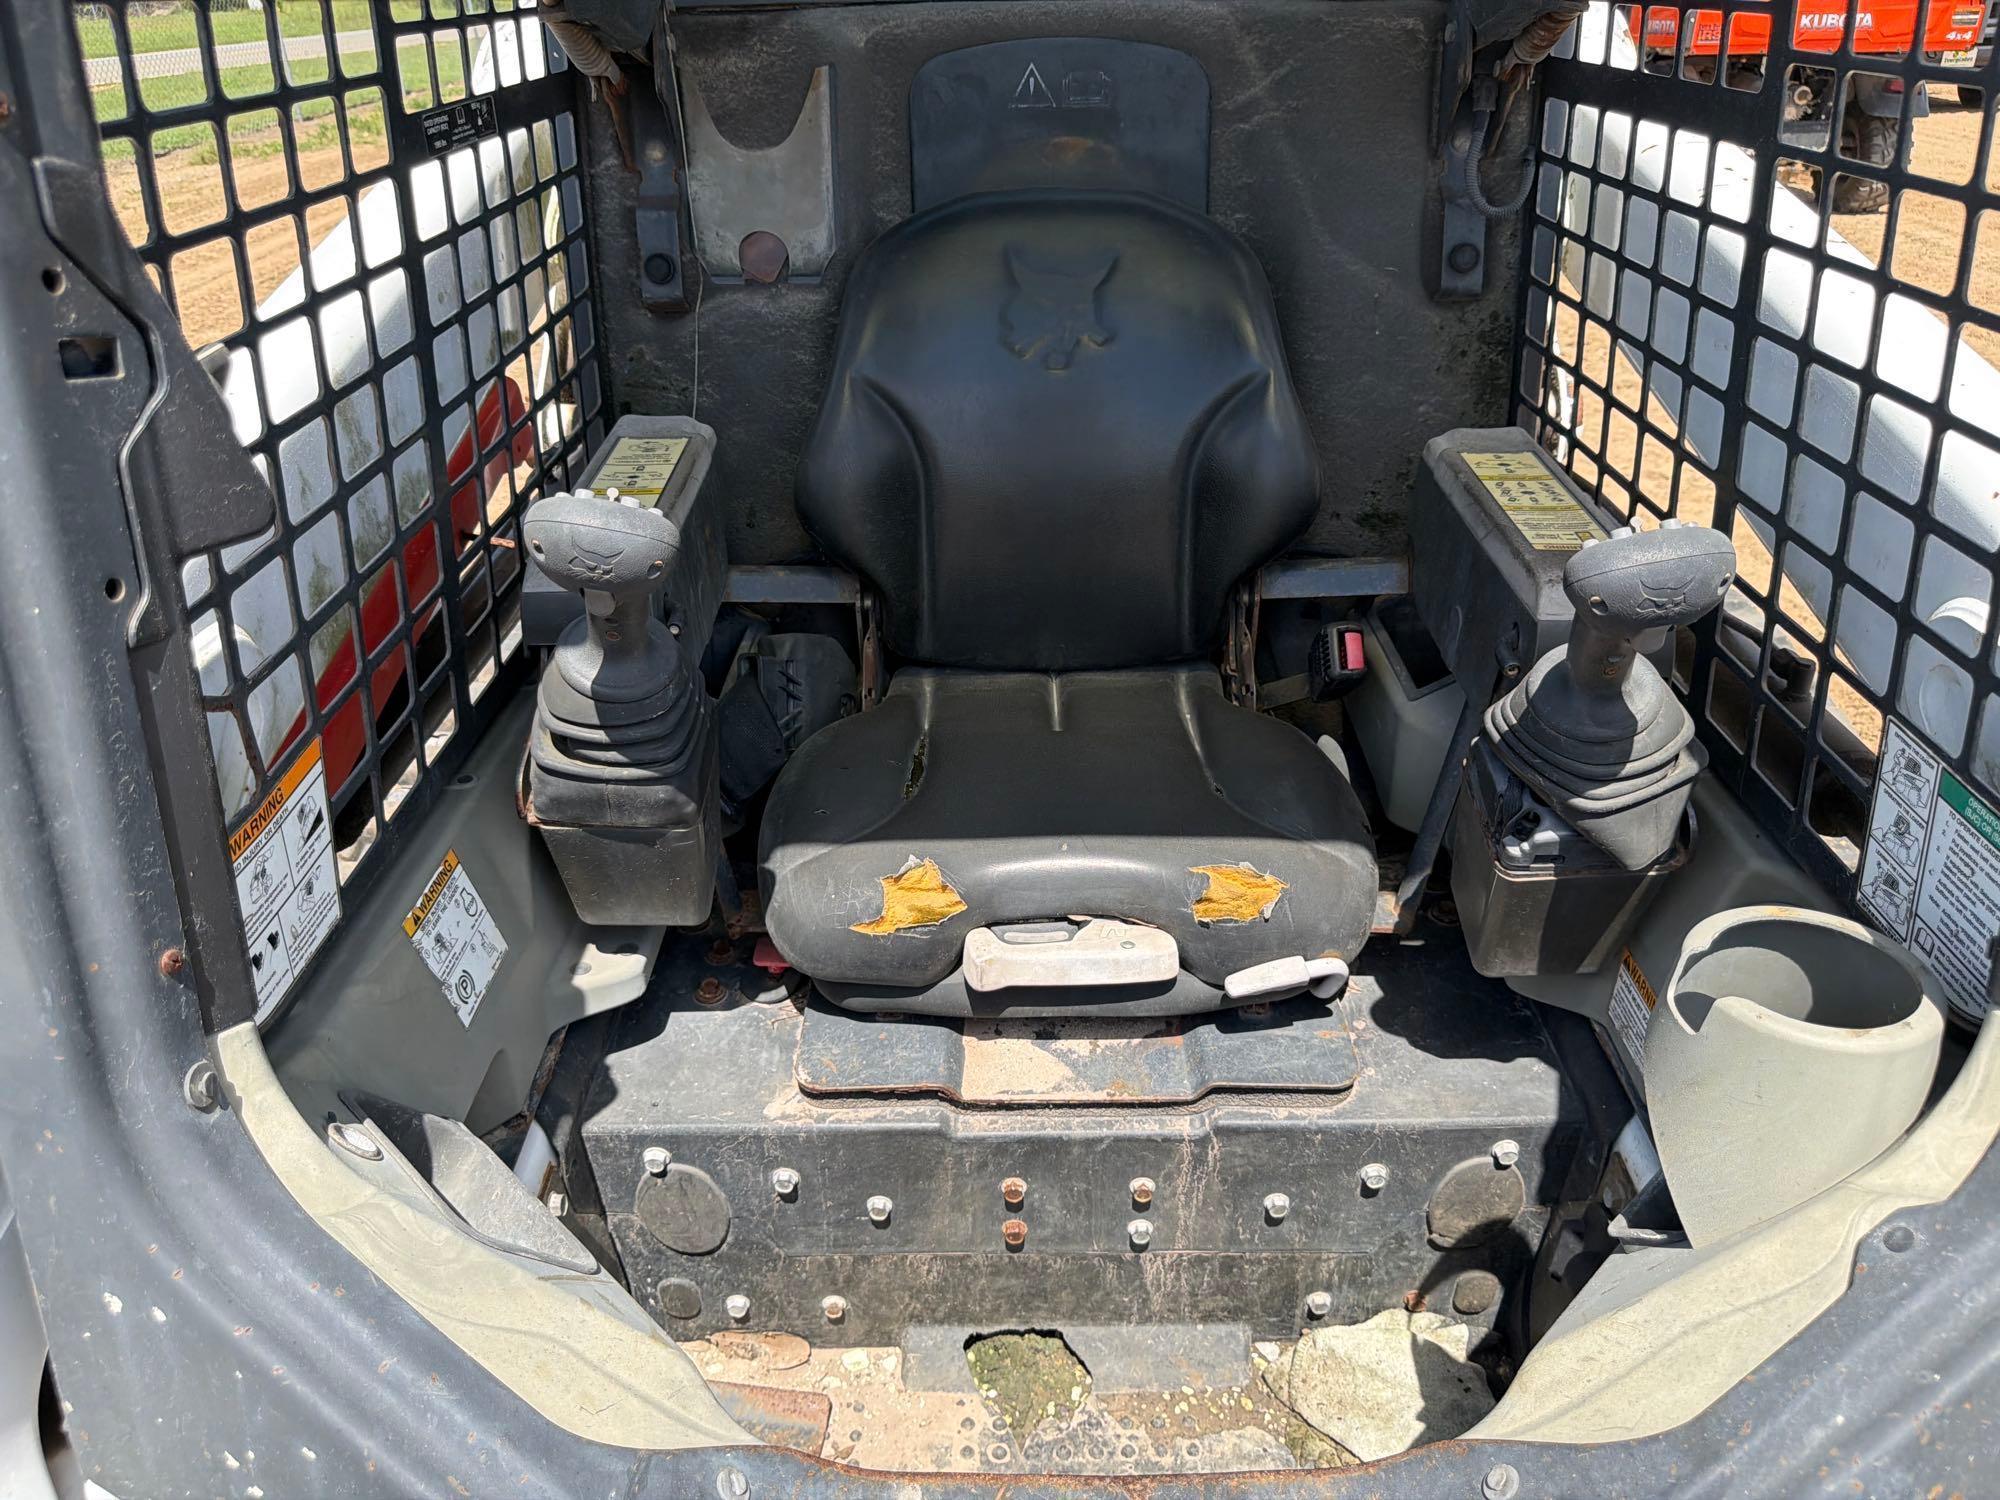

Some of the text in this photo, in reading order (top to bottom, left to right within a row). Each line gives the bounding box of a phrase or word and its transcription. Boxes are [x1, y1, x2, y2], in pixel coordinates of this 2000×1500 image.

[229, 788, 282, 856] WARNING
[242, 837, 262, 864] INJURY
[263, 827, 272, 839] OR
[272, 806, 288, 829] DEATH
[1949, 810, 1956, 820] TO
[1956, 818, 1980, 842] OPERATE
[1981, 822, 1991, 835] OR
[419, 860, 452, 912] WARNING
[431, 914, 441, 930] LEAVE
[447, 884, 458, 904] LOADER
